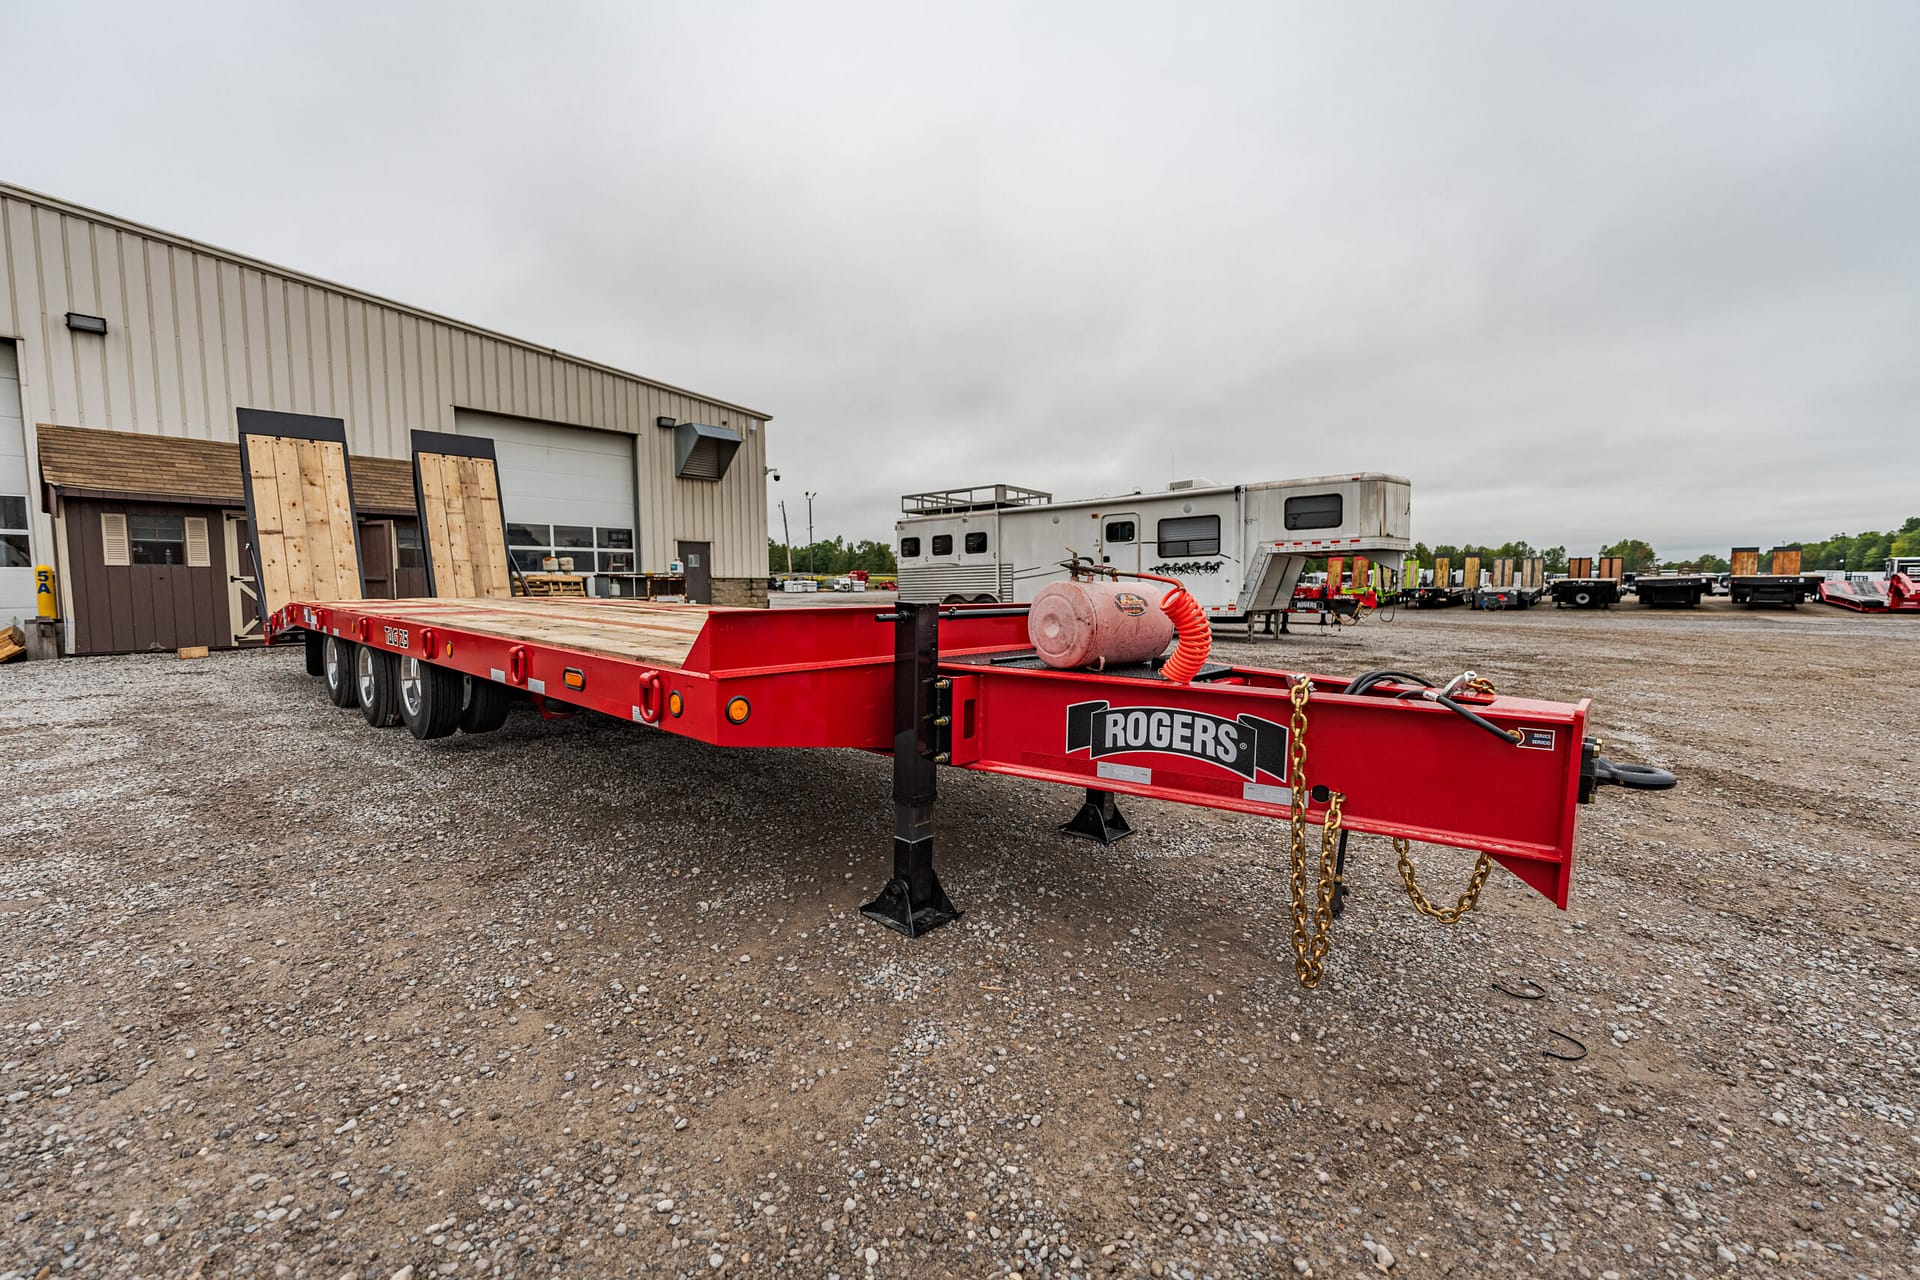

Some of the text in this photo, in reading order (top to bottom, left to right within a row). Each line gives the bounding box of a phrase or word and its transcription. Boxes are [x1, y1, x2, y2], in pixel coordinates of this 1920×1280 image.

[37, 571, 49, 582] 5
[37, 582, 51, 594] A
[384, 626, 409, 649] TAG 25
